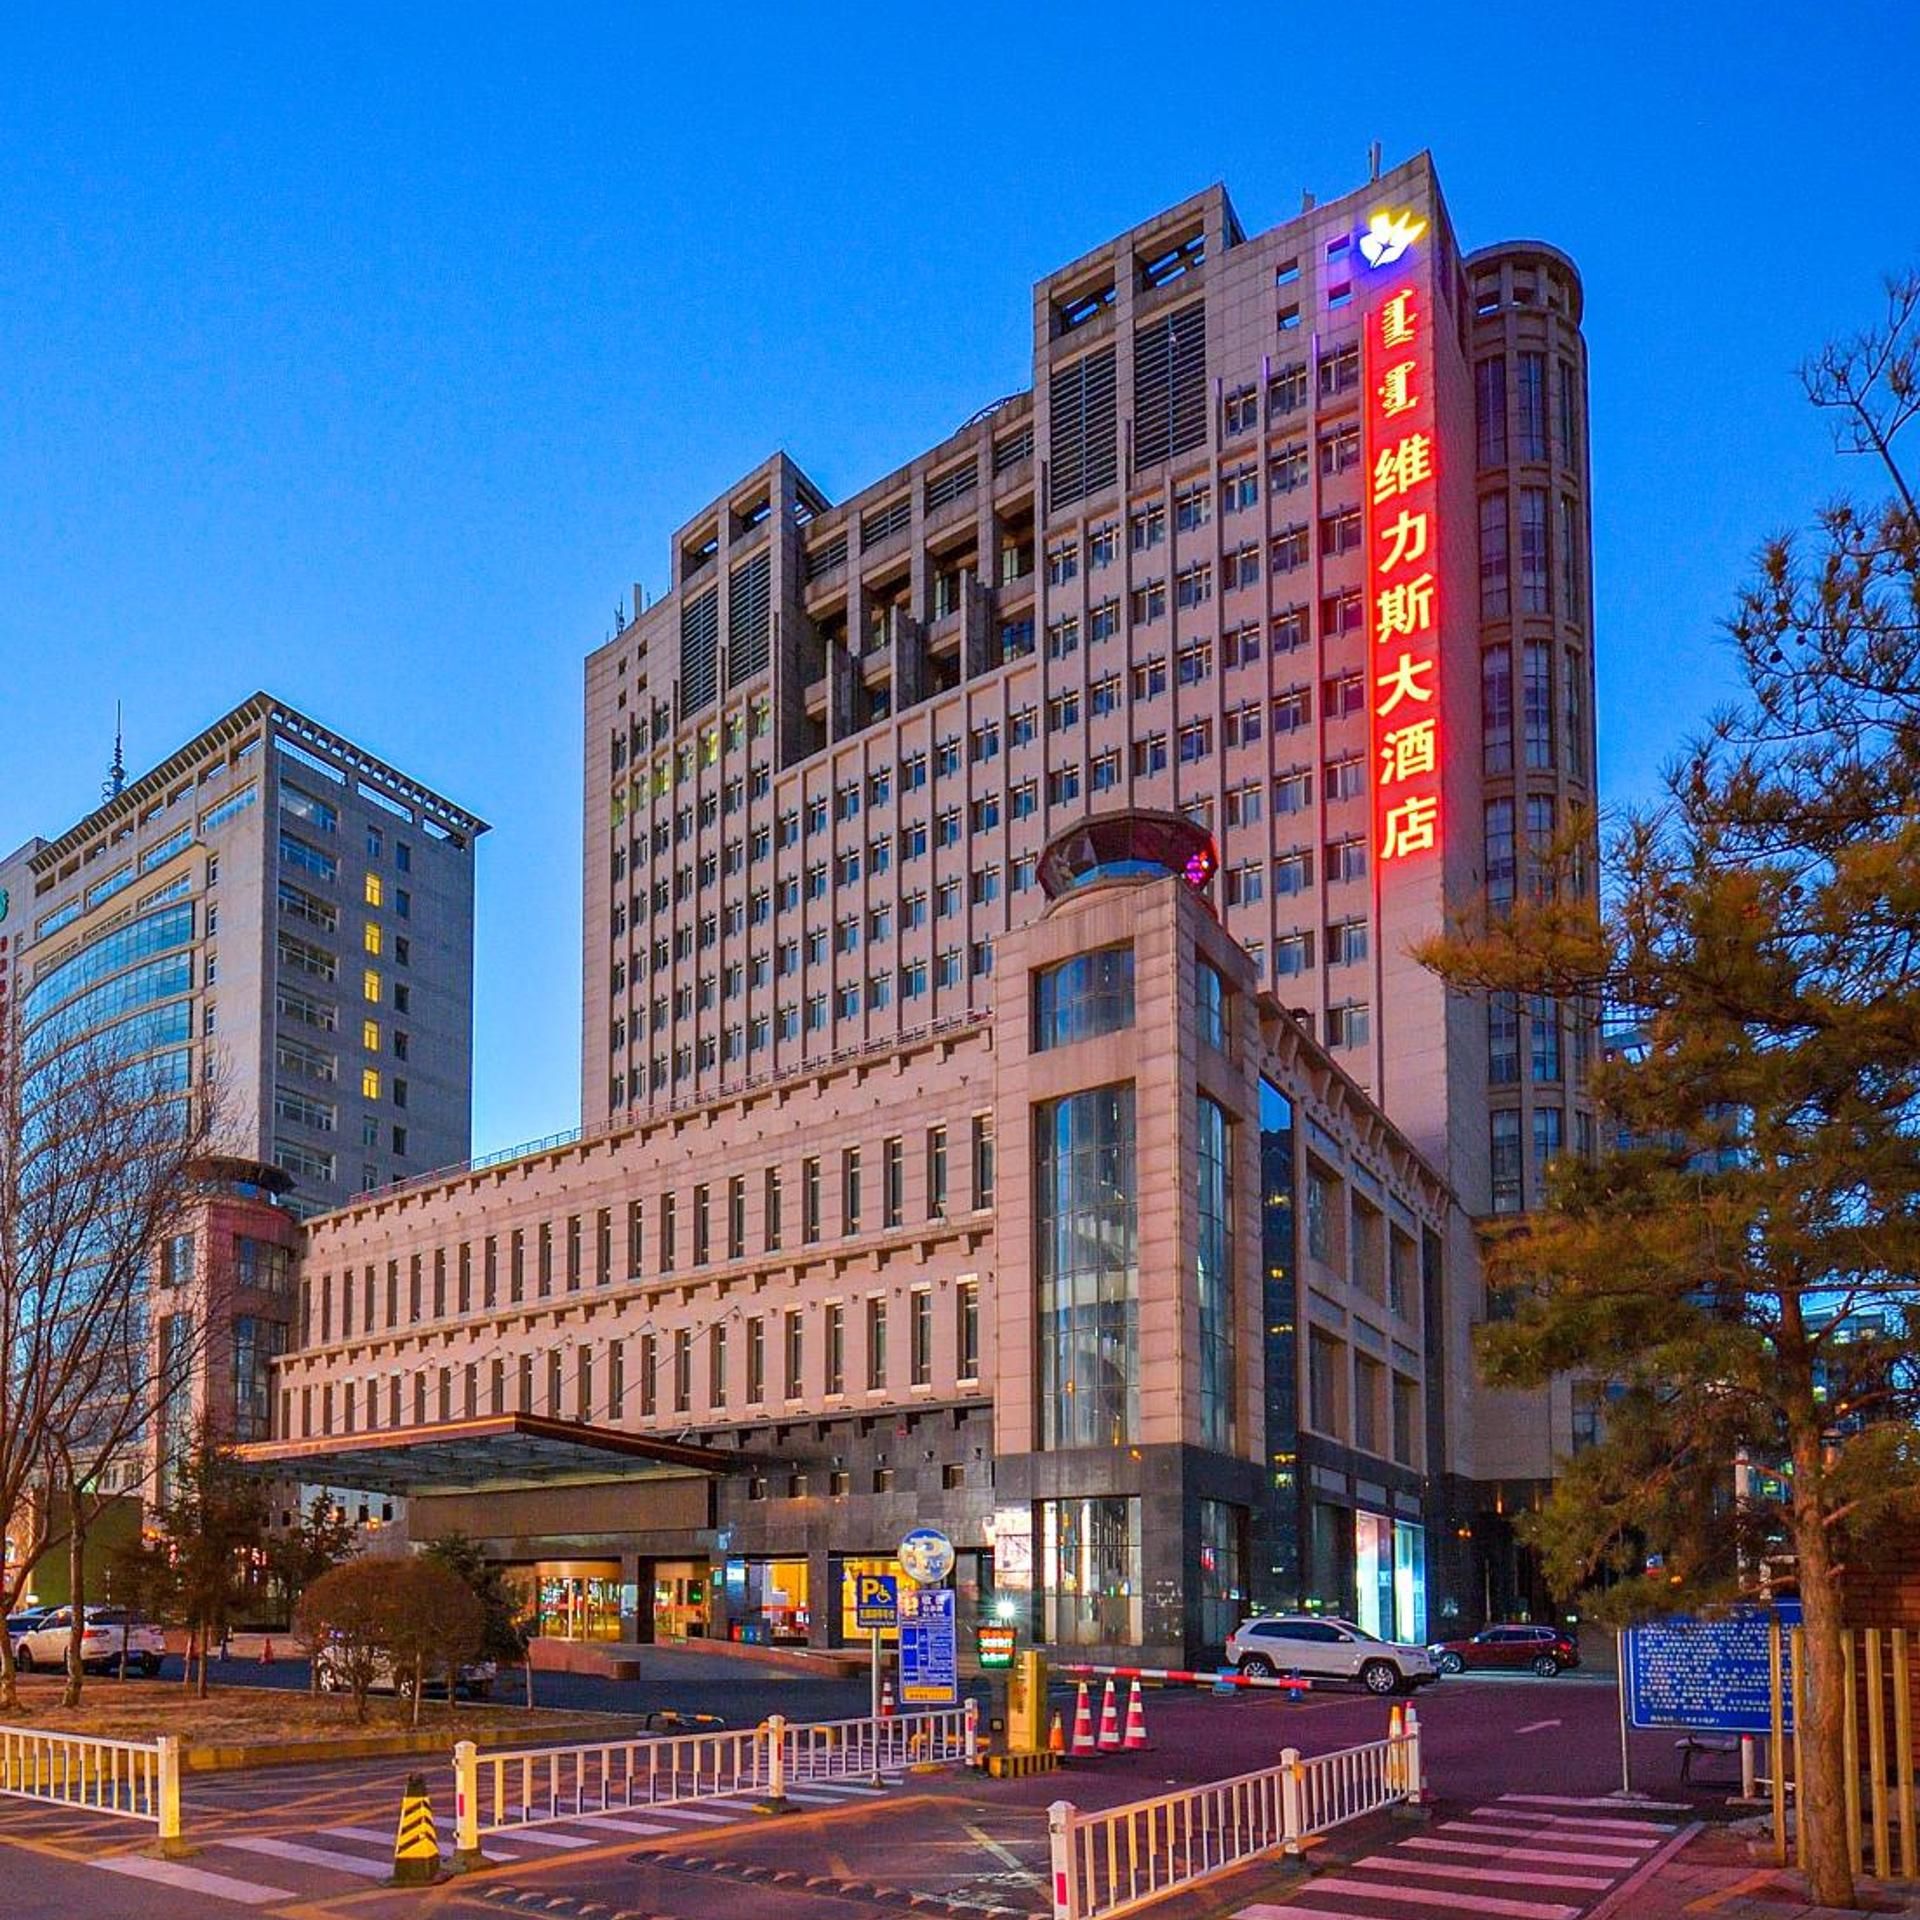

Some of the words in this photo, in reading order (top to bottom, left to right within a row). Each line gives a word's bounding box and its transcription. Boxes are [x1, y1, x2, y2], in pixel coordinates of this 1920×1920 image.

[1373, 433, 1437, 860] 维力斯大酒店
[862, 1578, 880, 1604] P
